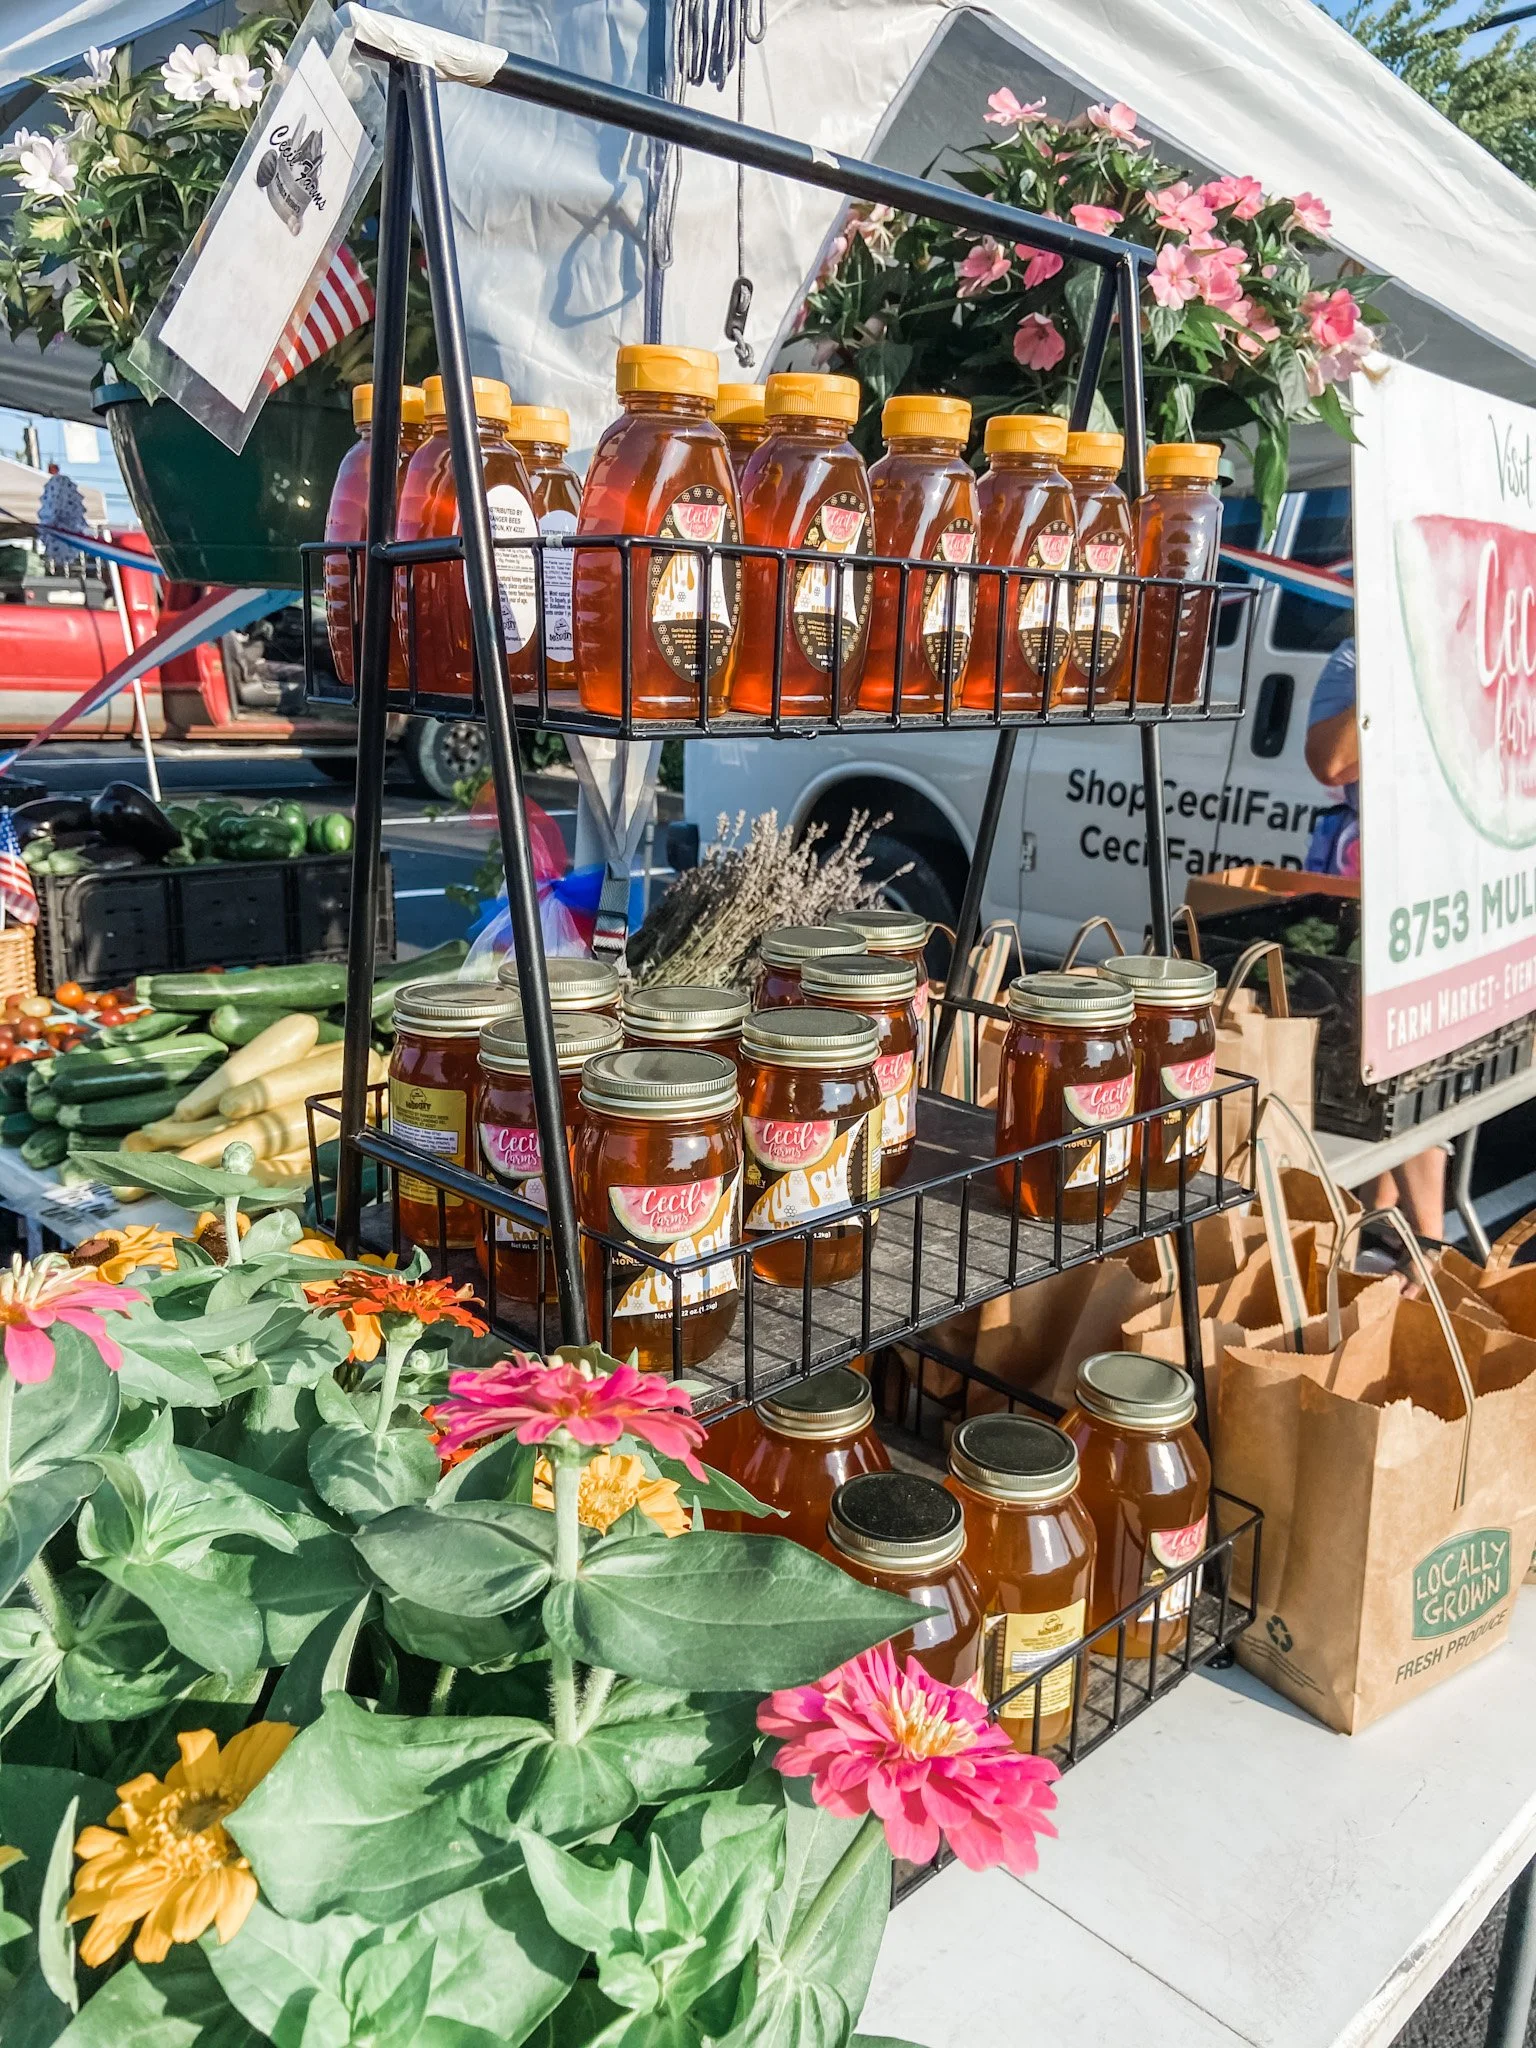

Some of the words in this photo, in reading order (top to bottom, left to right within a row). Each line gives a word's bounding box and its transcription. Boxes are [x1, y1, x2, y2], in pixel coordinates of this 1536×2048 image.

[269, 125, 304, 168] Cecil
[295, 151, 328, 211] Farms
[1488, 413, 1533, 509] Visit
[489, 507, 516, 516] STRIBUTED
[1388, 890, 1469, 964] 8753
[1482, 866, 1536, 934] MUL
[1387, 1000, 1433, 1051] FARM
[875, 1053, 905, 1080] ecil
[1090, 1079, 1126, 1107] Cecil
[763, 1122, 813, 1151] Cecil
[504, 1149, 538, 1169] farms
[768, 1142, 801, 1161] farms
[641, 1181, 701, 1216] Cecil
[650, 1211, 689, 1233] farms
[697, 1280, 732, 1301] HONEY
[654, 1312, 667, 1320] Net
[1416, 1540, 1507, 1601] LOCALLY
[1422, 1568, 1500, 1625] GROWN
[1394, 1644, 1444, 1685] FRESH
[1446, 1608, 1509, 1660] PRODUCE
